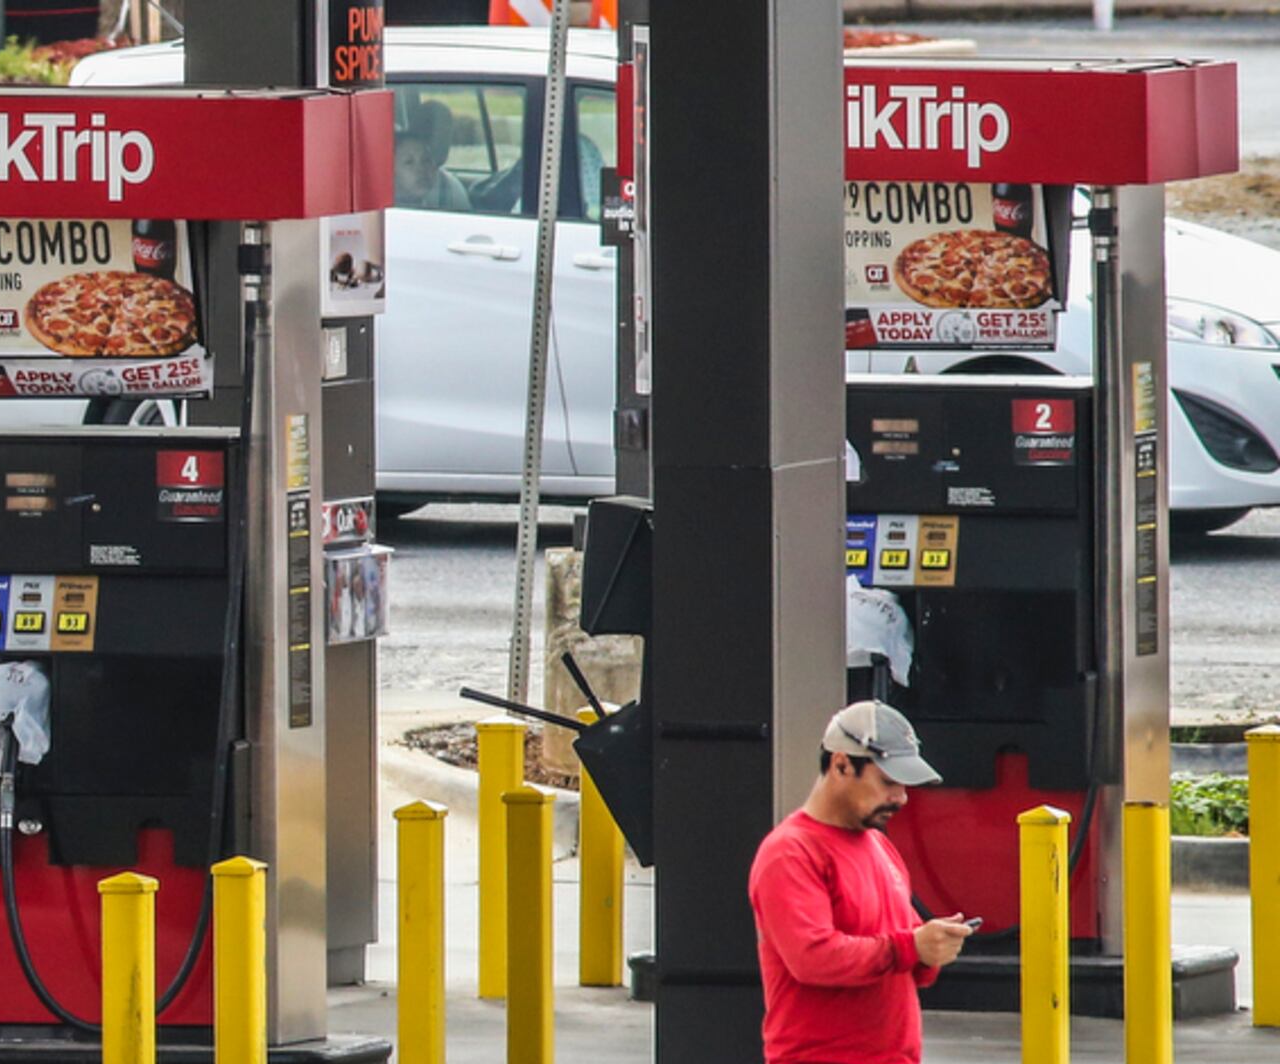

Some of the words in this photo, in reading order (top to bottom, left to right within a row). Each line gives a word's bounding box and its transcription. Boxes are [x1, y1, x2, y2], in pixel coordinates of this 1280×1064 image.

[335, 45, 381, 80] SPICE
[847, 85, 1009, 168] ikTrip
[864, 183, 973, 224] COMBO
[846, 231, 891, 247] OPPING
[877, 313, 933, 326] APPLY
[977, 313, 1013, 327] GET
[878, 327, 933, 340] TODAY
[979, 329, 1002, 337] PER
[1005, 329, 1047, 337] GALLON
[15, 370, 72, 383] APPLY
[122, 365, 162, 382] GET
[17, 383, 76, 394] TODAY
[152, 377, 201, 389] GALLON
[1035, 403, 1052, 429] 2
[1015, 435, 1075, 448] Guaranteed
[181, 455, 199, 482] 4
[158, 489, 222, 503] Guaranteed
